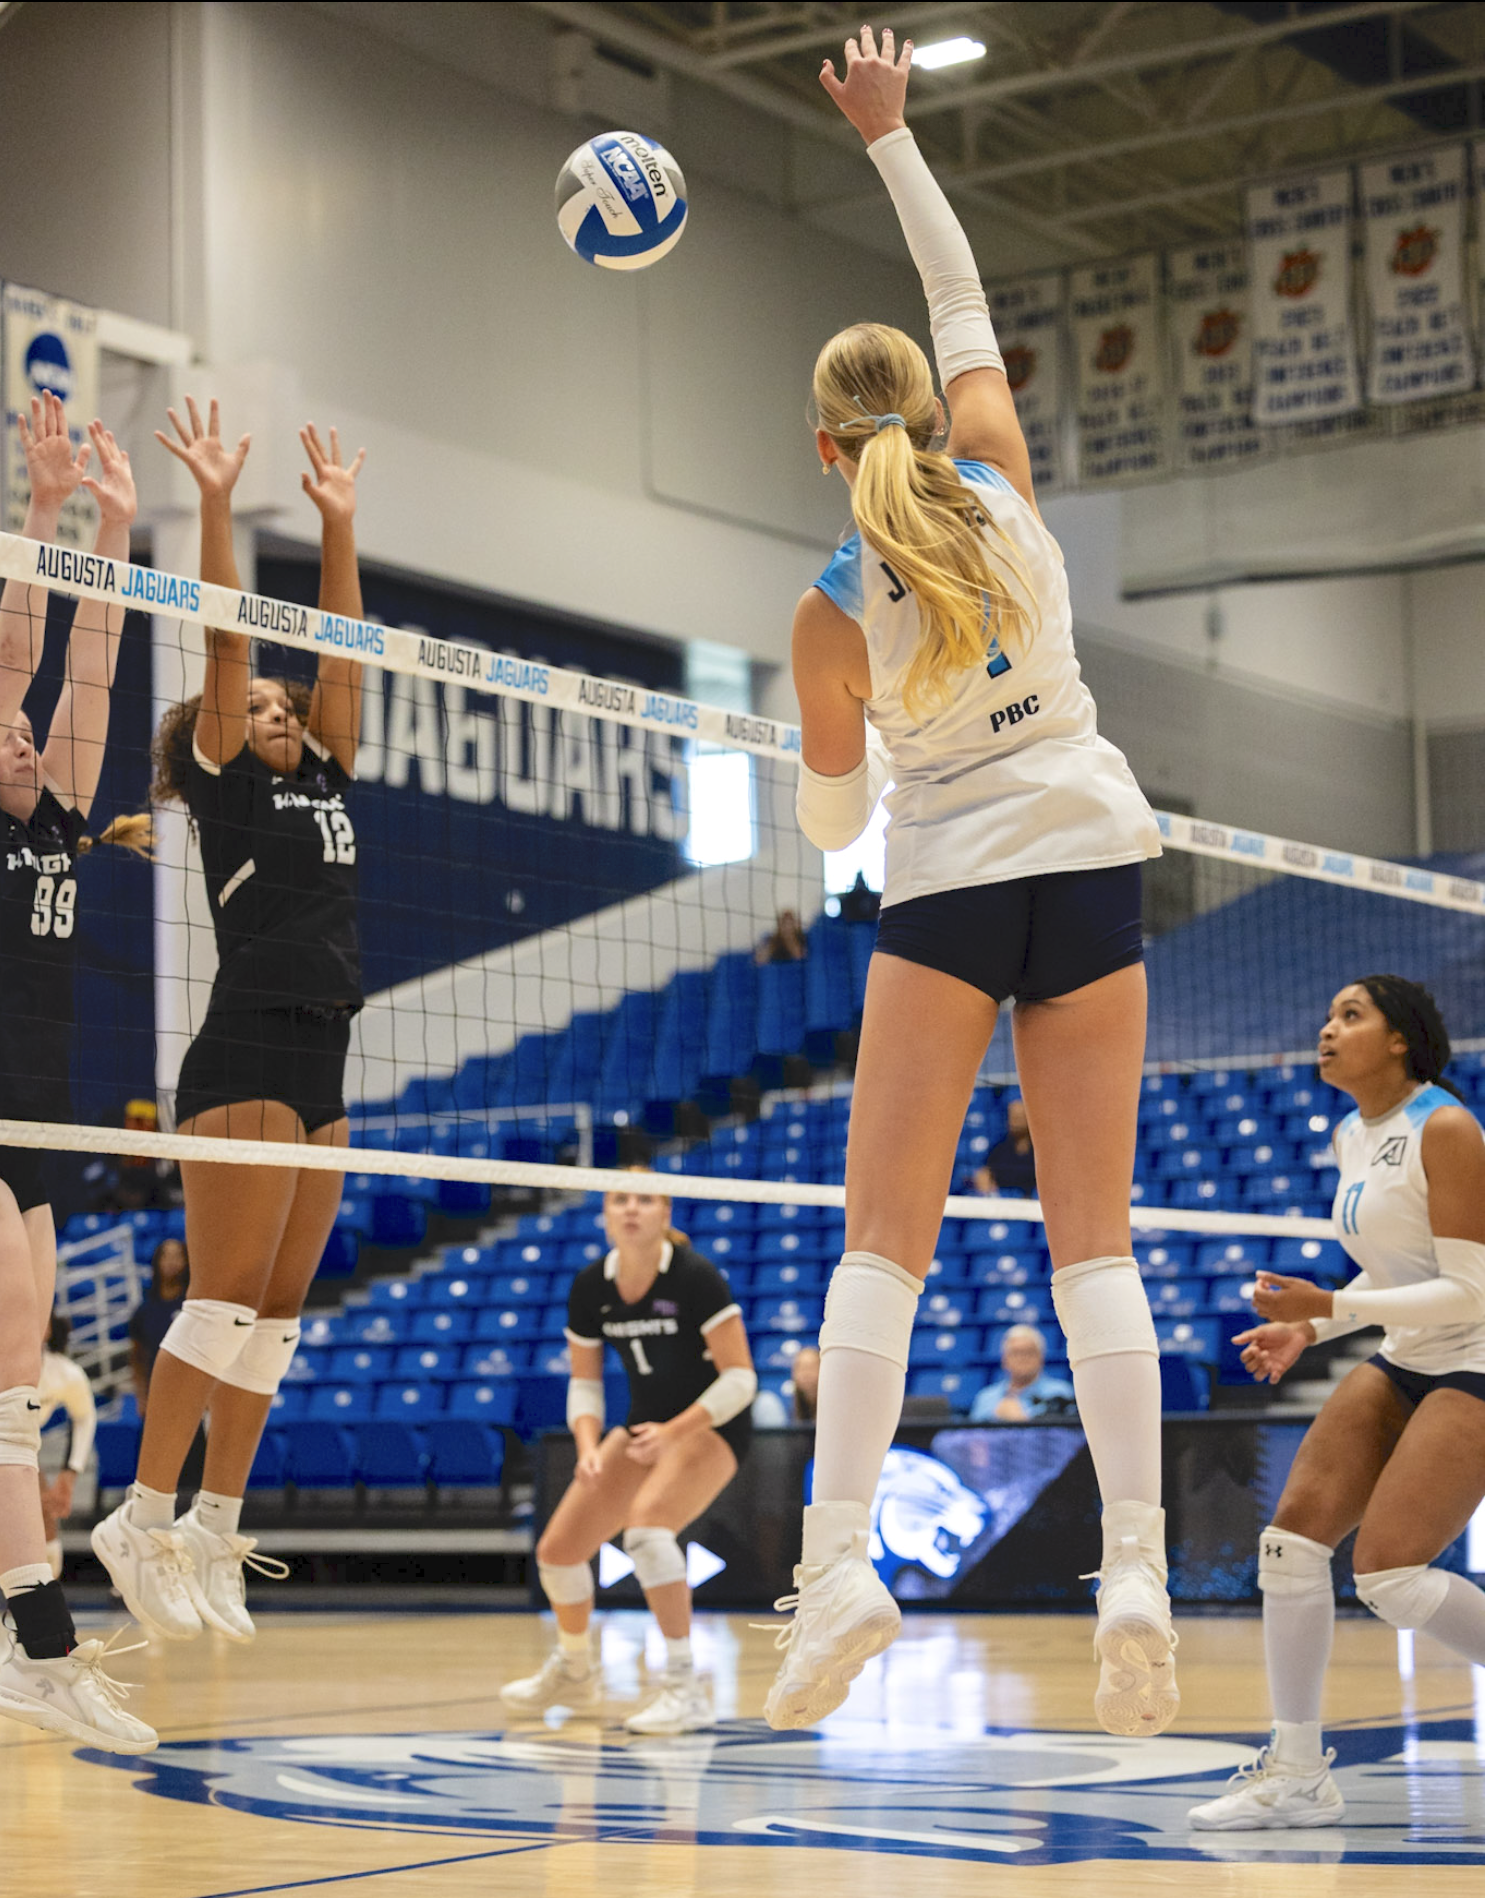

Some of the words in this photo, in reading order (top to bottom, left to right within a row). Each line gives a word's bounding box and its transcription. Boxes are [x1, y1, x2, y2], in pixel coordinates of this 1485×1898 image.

[603, 146, 648, 202] NCAA
[620, 135, 666, 197] molten
[595, 187, 623, 219] Touch
[36, 545, 116, 593] AUGUSTA
[121, 567, 202, 612] JAGUARS
[237, 595, 309, 638] AUGUSTA
[314, 615, 385, 656] JAGUARS
[417, 639, 482, 680] AUGUSTA
[486, 657, 551, 696] JAGUARS
[578, 679, 636, 716] AUGUSTA
[640, 694, 699, 730] JAGUARS
[989, 694, 1041, 733] PBC
[313, 809, 357, 866] 12
[31, 875, 77, 938] 99
[629, 1338, 654, 1376] 1
